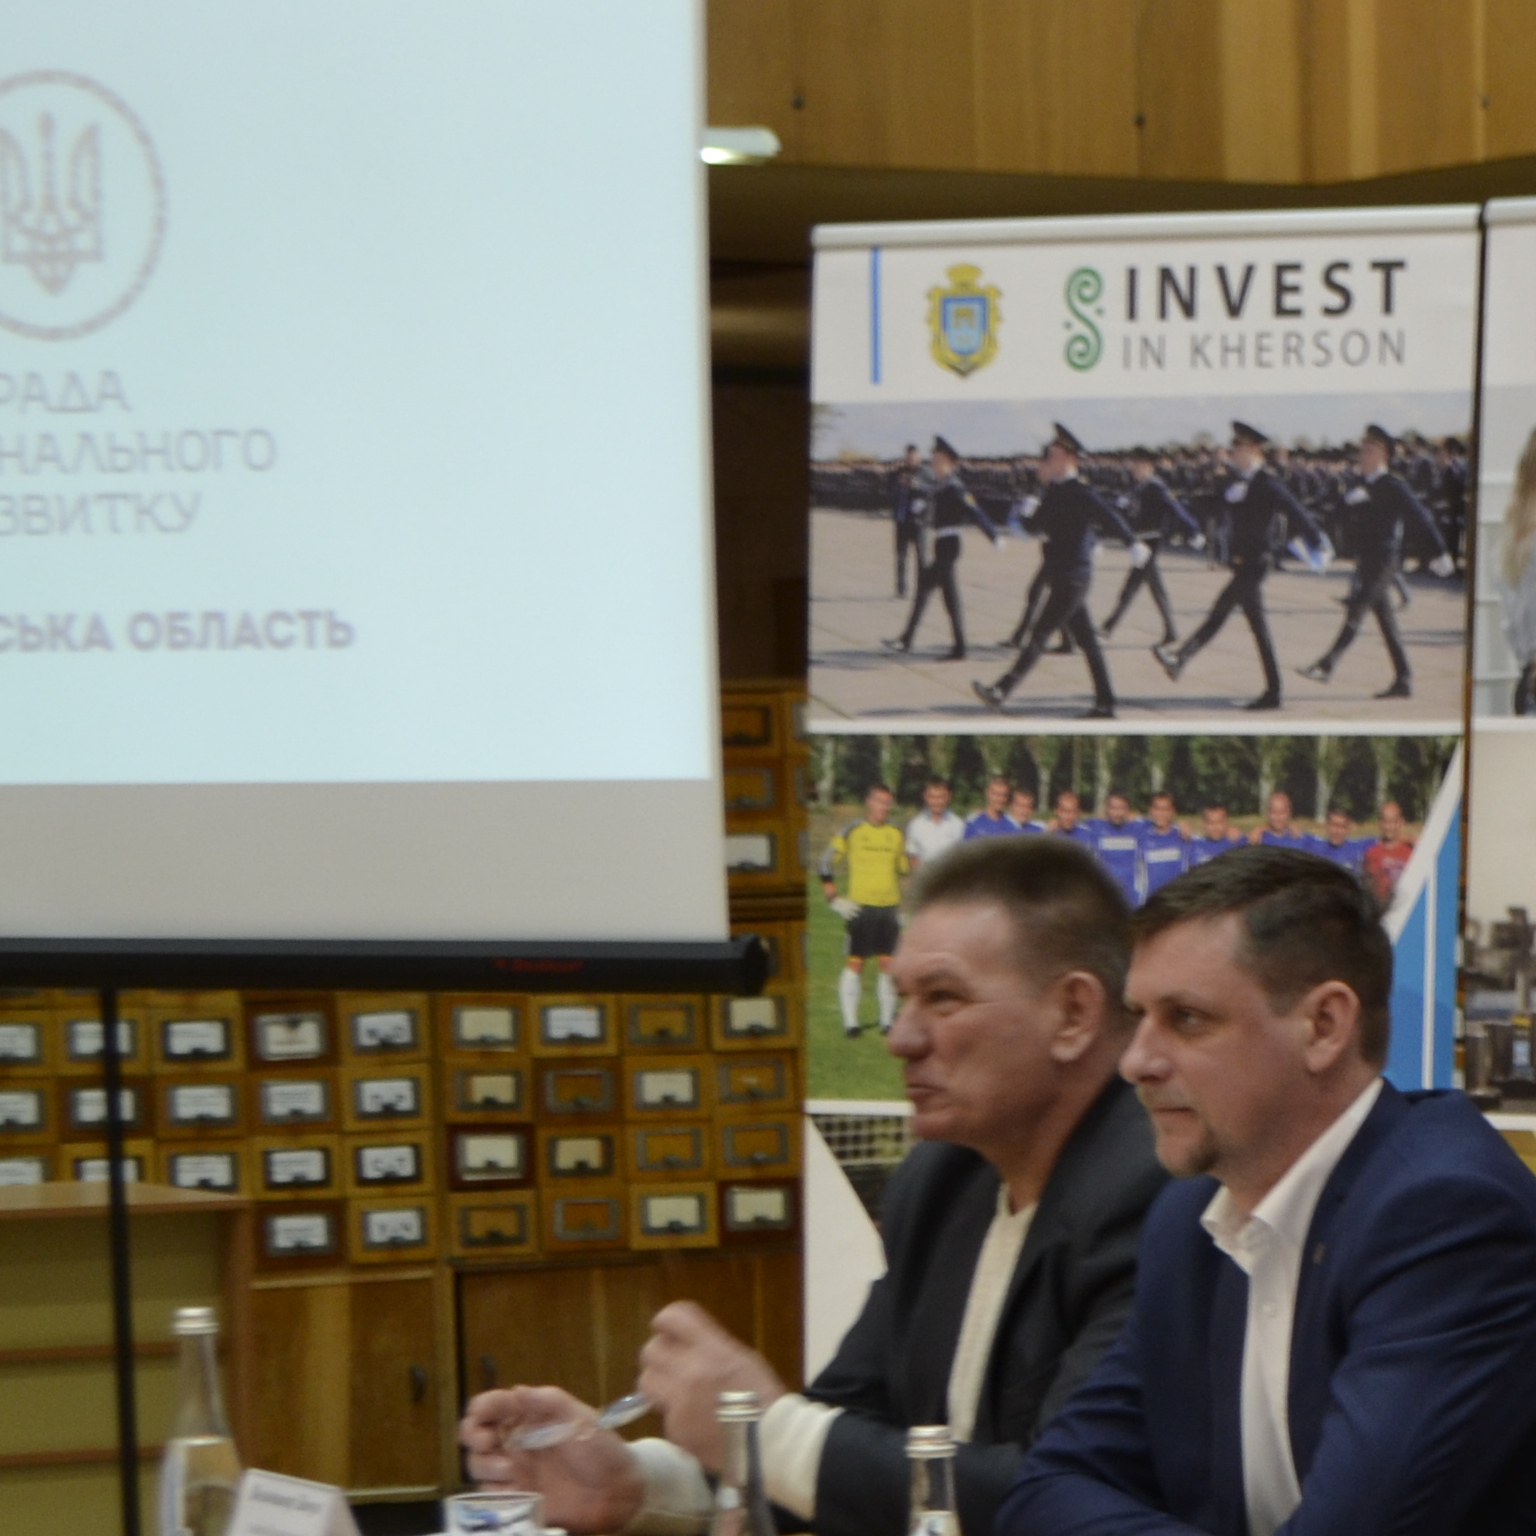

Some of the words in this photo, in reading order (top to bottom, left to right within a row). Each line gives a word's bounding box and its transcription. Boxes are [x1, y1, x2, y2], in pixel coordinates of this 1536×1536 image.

[1124, 261, 1407, 321] INVEST
[1123, 334, 1167, 370] IN
[1189, 330, 1407, 368] KHERSON
[127, 609, 356, 652] ОБЛАСТЬ
